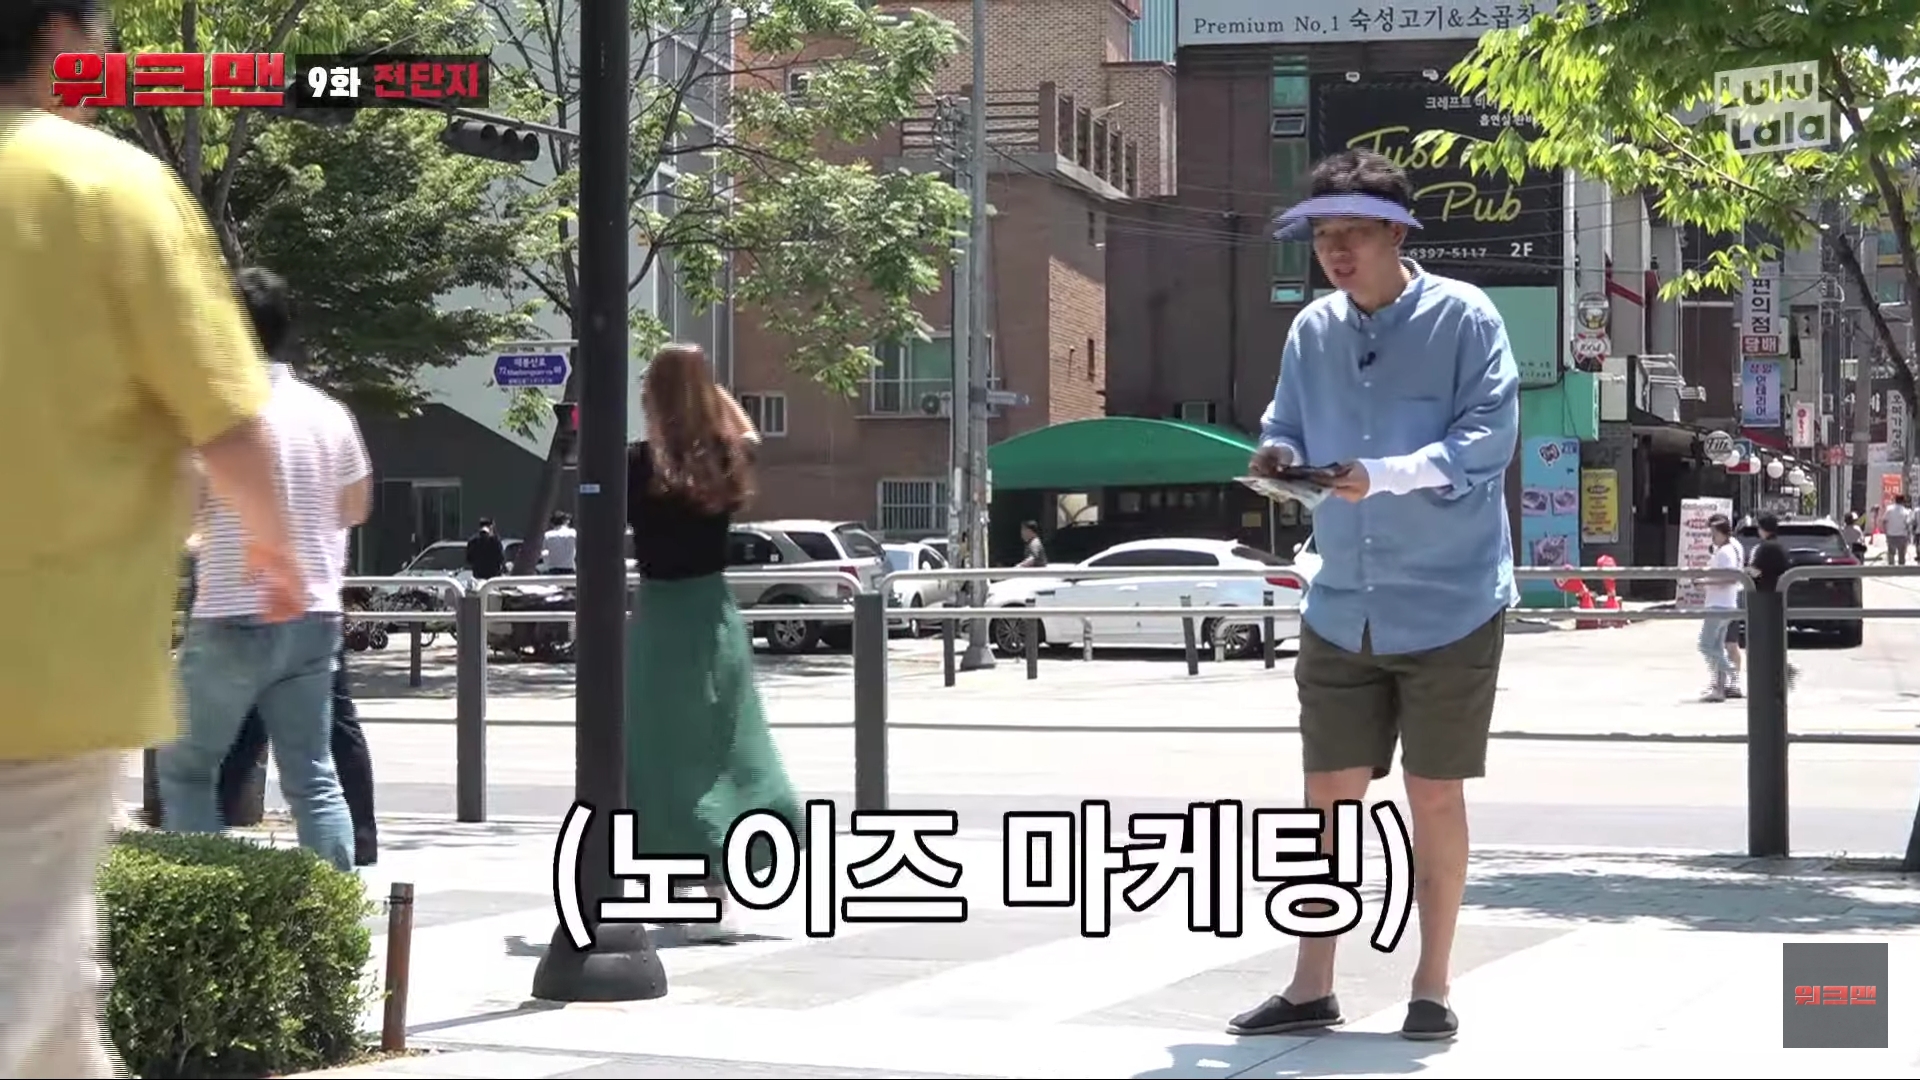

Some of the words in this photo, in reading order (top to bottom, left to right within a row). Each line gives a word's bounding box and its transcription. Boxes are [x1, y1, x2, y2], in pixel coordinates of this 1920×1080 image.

[1194, 17, 1285, 35] Premium
[1295, 16, 1340, 35] No.1
[1413, 181, 1522, 222] Pub
[1510, 241, 1534, 258] 2F
[1751, 278, 1771, 334] 편의점
[1744, 336, 1777, 352] 담배
